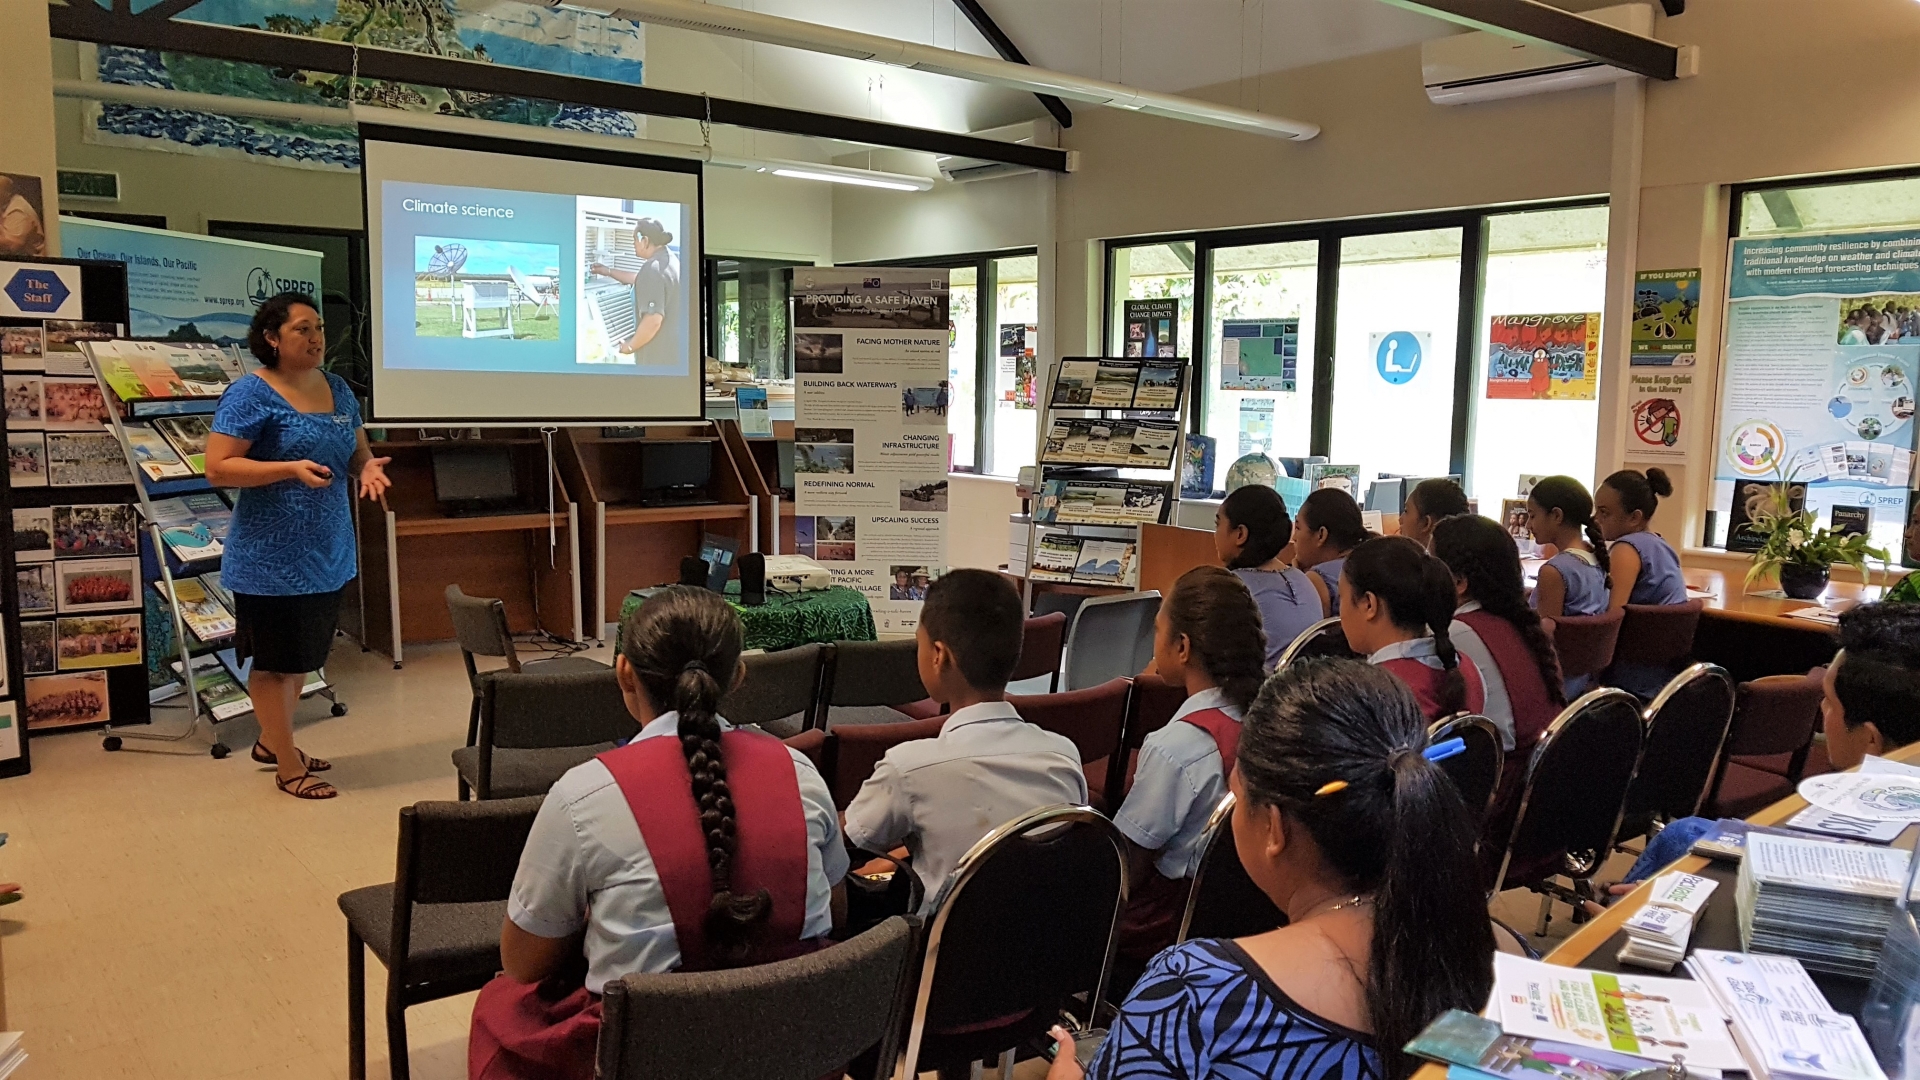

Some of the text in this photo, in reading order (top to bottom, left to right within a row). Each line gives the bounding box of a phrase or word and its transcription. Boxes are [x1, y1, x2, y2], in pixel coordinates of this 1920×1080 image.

[402, 198, 514, 218] Climate science
[1744, 246, 1784, 255] Increasing
[1785, 243, 1827, 254] community
[1829, 242, 1869, 250] resilience
[1870, 240, 1880, 250] by
[77, 248, 90, 258] Our
[120, 252, 133, 263] Our
[134, 254, 161, 268] Islands,
[162, 258, 174, 268] Our
[176, 258, 197, 270] Pacific
[1744, 256, 1782, 265] traditional
[1784, 254, 1827, 264] knowledge
[1840, 252, 1874, 261] weather
[1746, 262, 1919, 276] with modern climate forecasting techniques
[26, 279, 49, 289] The
[24, 293, 52, 302] Staff
[204, 296, 245, 307] www.sprep.org
[806, 295, 938, 305] PROVIDING A SAFE HAVEN
[1492, 314, 1600, 328] Mangroves
[1631, 374, 1692, 385] Please Keep Quiet
[1658, 386, 1682, 394] Library
[1878, 496, 1904, 505] SPREP
[1834, 510, 1866, 520] Panarchy
